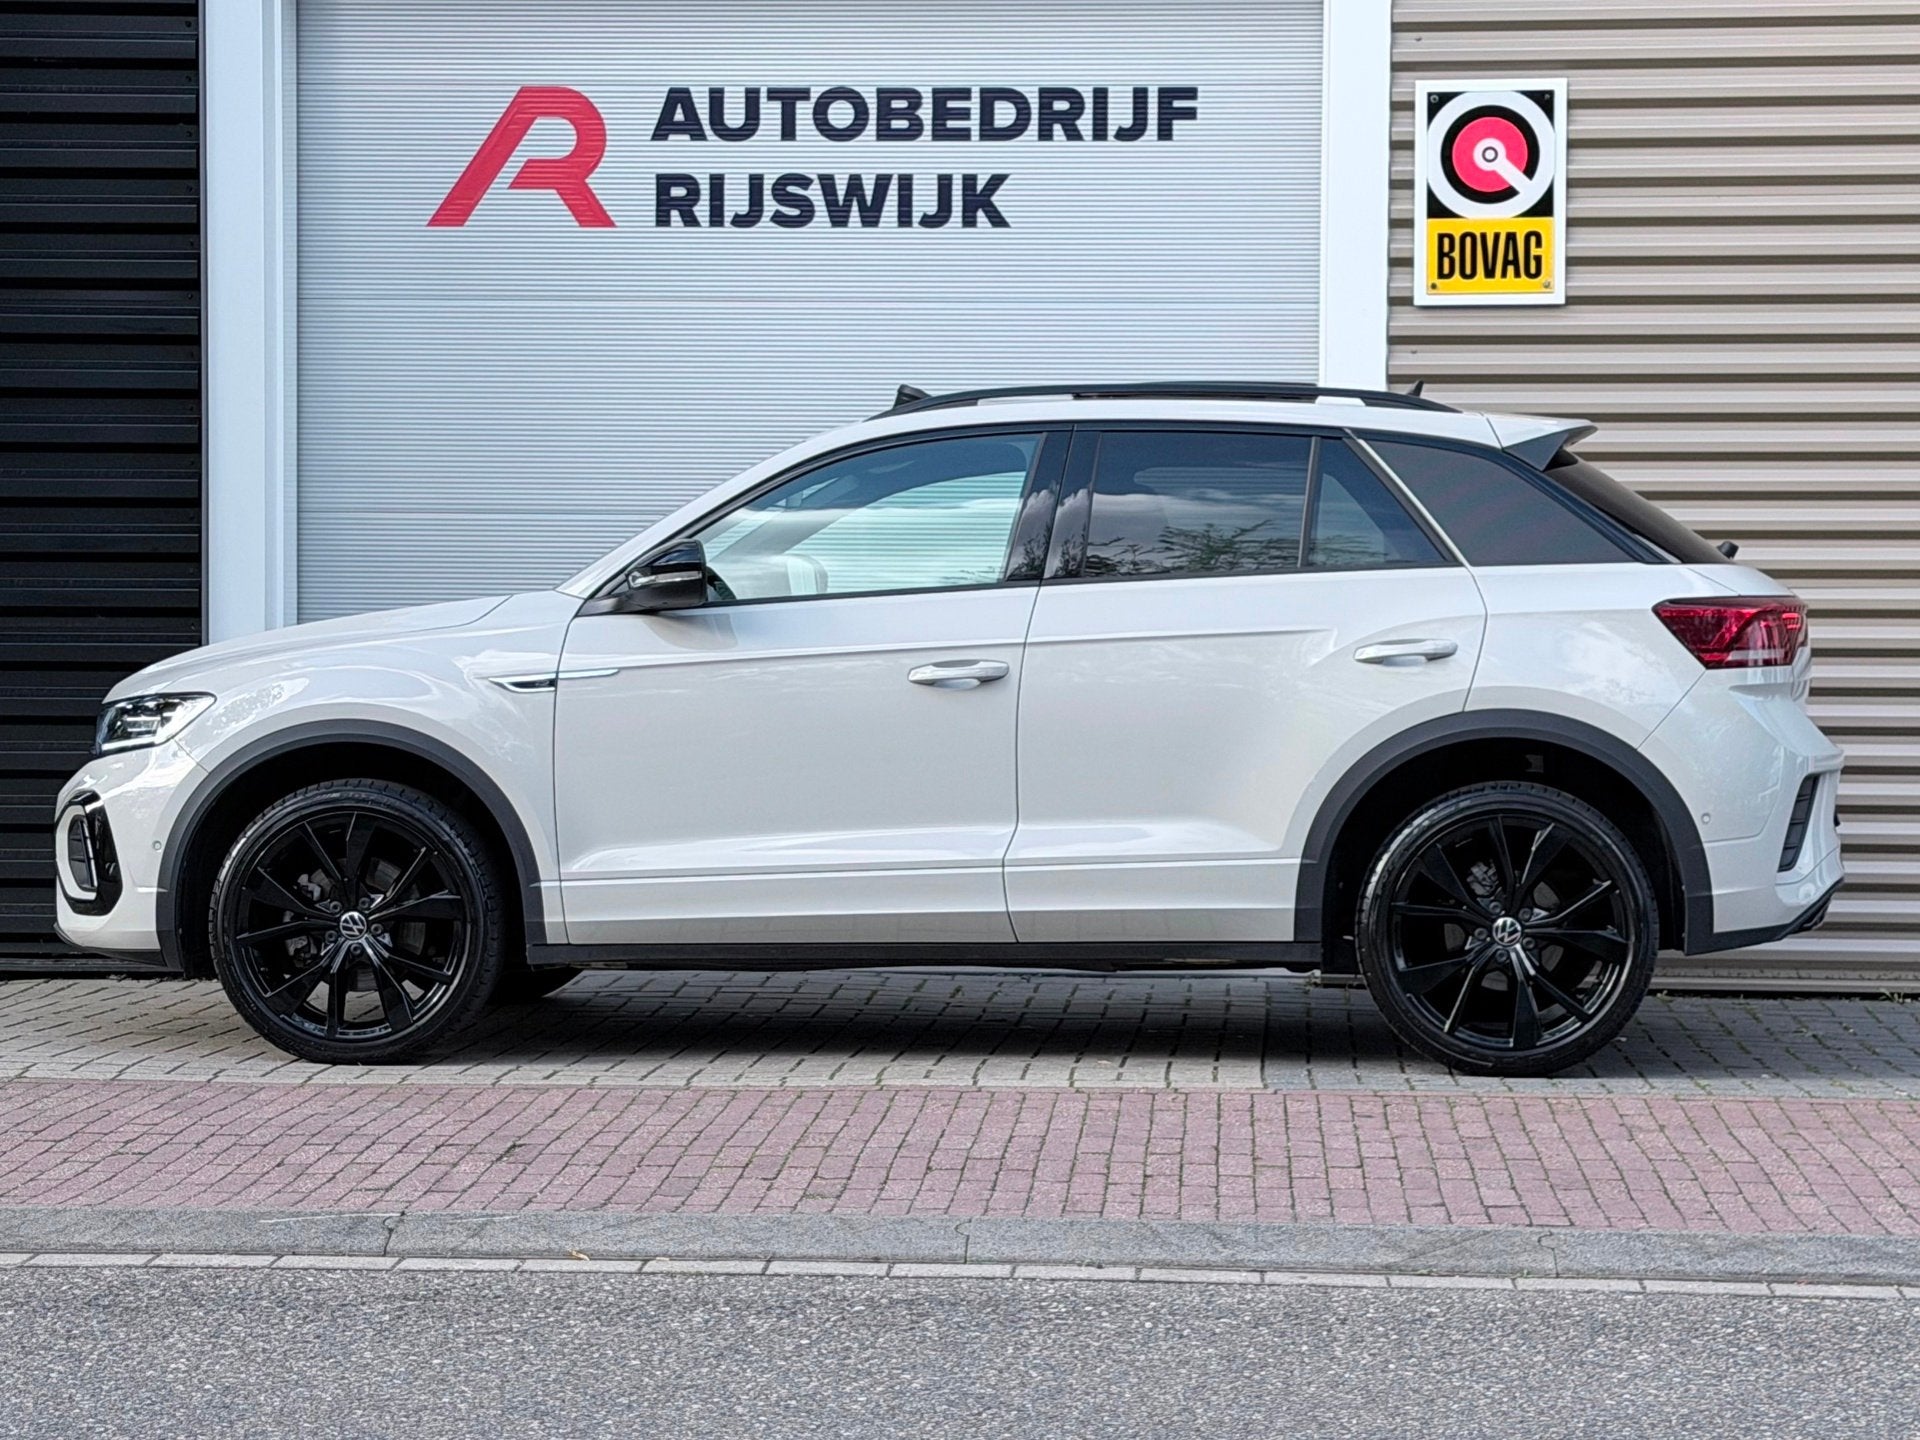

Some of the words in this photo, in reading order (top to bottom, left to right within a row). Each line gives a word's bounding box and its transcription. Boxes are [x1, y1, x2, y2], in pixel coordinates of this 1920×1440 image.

[652, 86, 1198, 142] AUTOBEDRIJF
[655, 173, 1010, 229] RIJSWIJK
[1436, 230, 1543, 280] BOVAG
